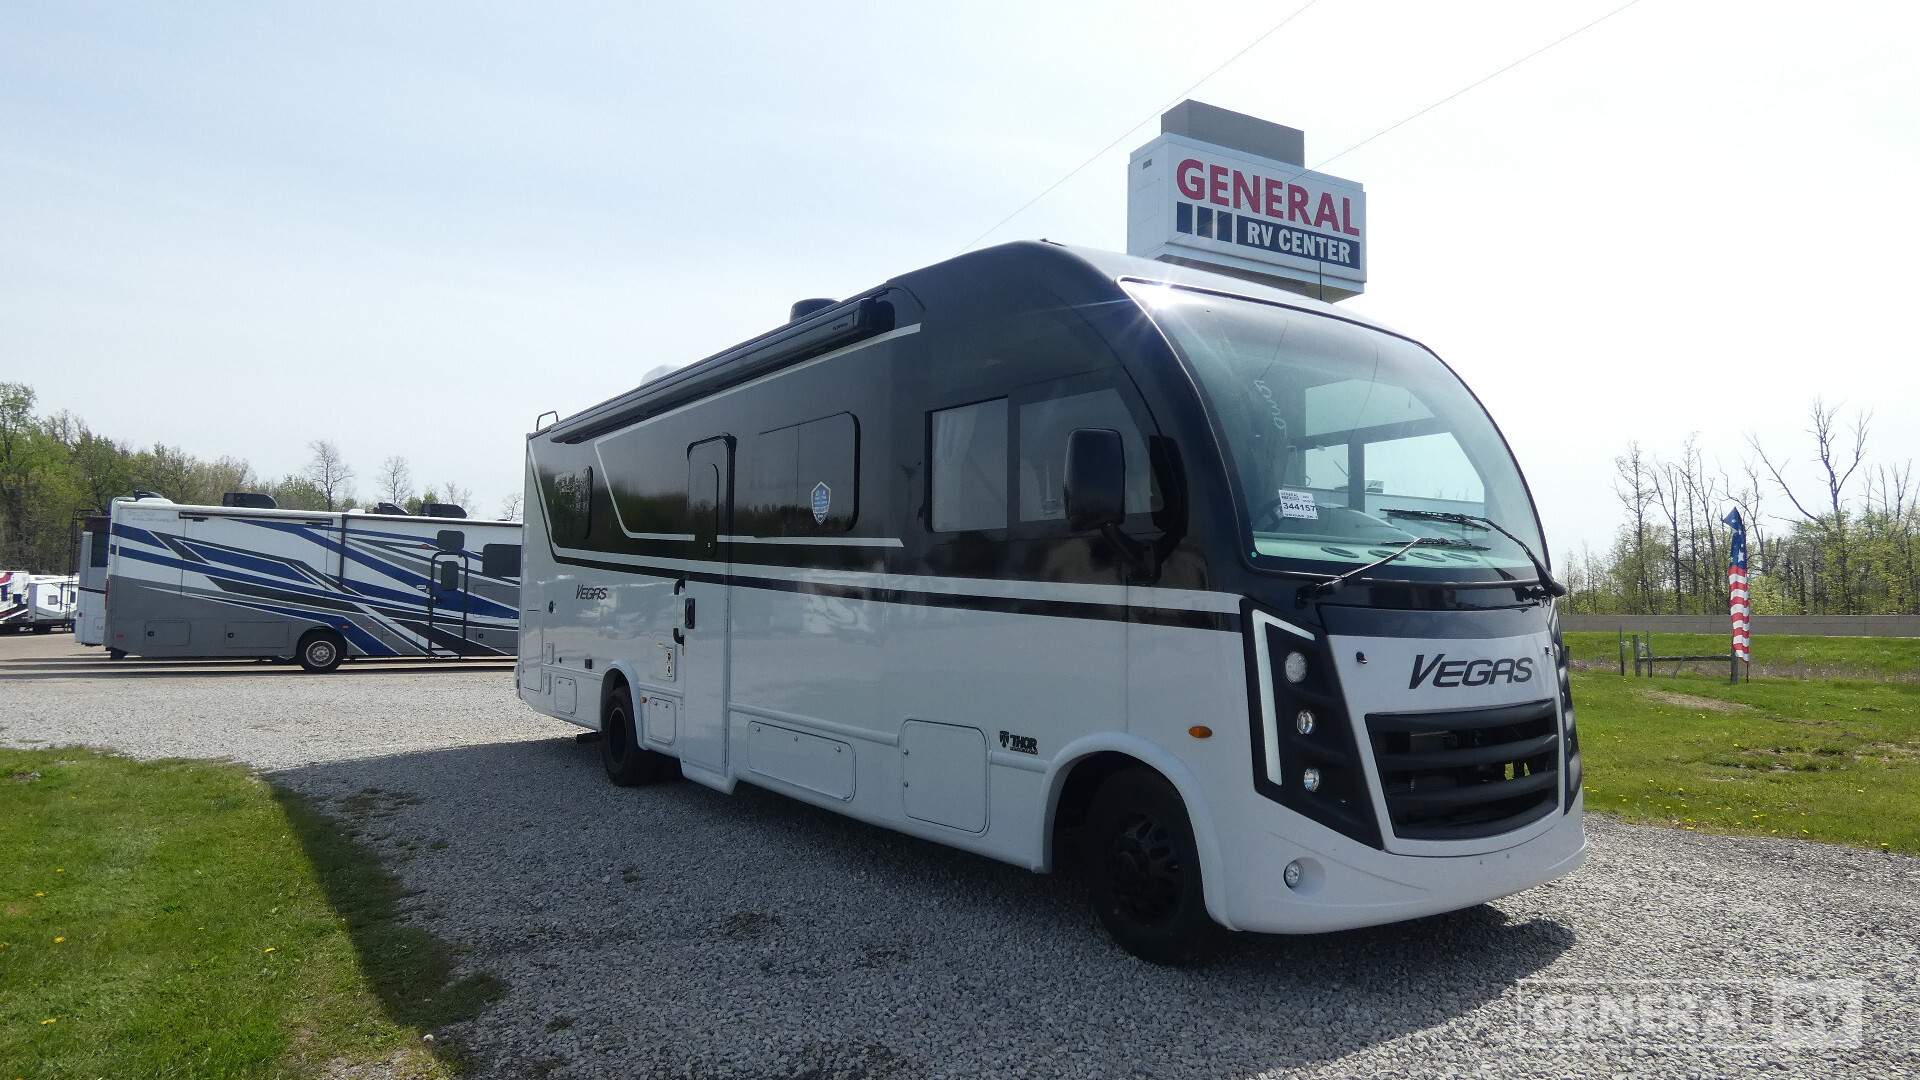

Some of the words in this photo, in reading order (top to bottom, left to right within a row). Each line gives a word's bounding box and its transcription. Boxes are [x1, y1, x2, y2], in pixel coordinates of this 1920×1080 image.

[1176, 158, 1360, 236] GENERAL
[1247, 221, 1274, 247] RV
[1278, 225, 1351, 264] CENTER
[1282, 502, 1316, 512] 344157
[576, 584, 608, 600] VEGAS
[1408, 653, 1534, 690] VEGAS
[1010, 734, 1038, 752] THOR
